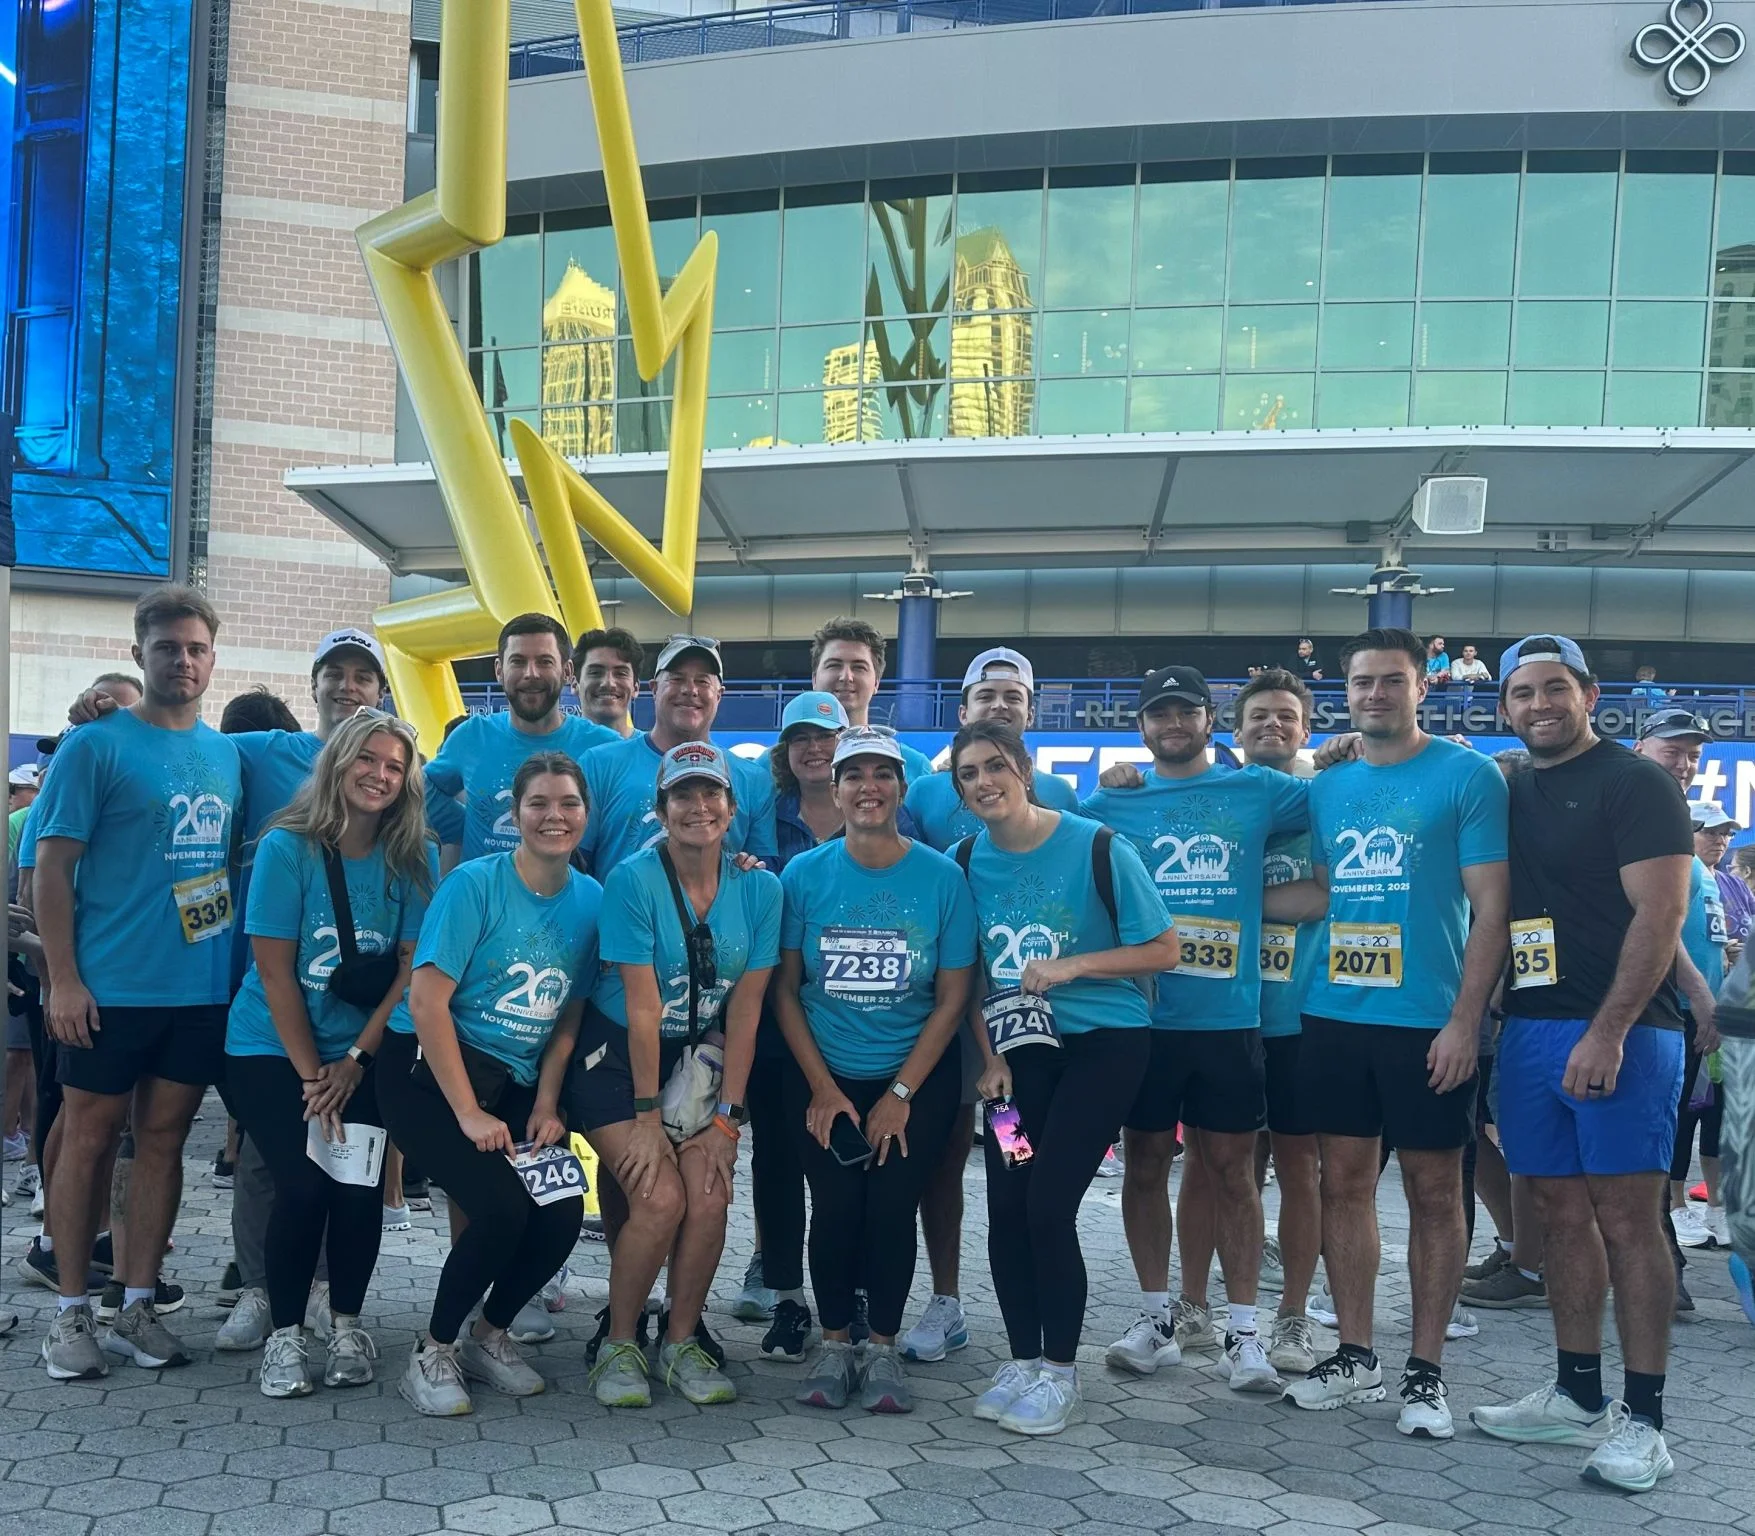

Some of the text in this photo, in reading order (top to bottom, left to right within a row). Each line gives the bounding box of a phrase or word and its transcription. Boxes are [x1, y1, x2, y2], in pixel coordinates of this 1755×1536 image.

[1151, 833, 1239, 883] 20 TH
[1334, 825, 1414, 880] 20 TH
[1161, 873, 1223, 881] ANNIVERSARY
[1200, 888, 1215, 897] 22,
[1022, 940, 1048, 948] MOFFITT
[1051, 930, 1069, 943] TH
[825, 954, 900, 980] 7238
[1334, 949, 1392, 975] 2071
[1514, 948, 1550, 975] 35
[495, 962, 570, 1020] 20
[481, 1010, 532, 1033] NOVEMBER
[988, 1010, 1053, 1043] 7241
